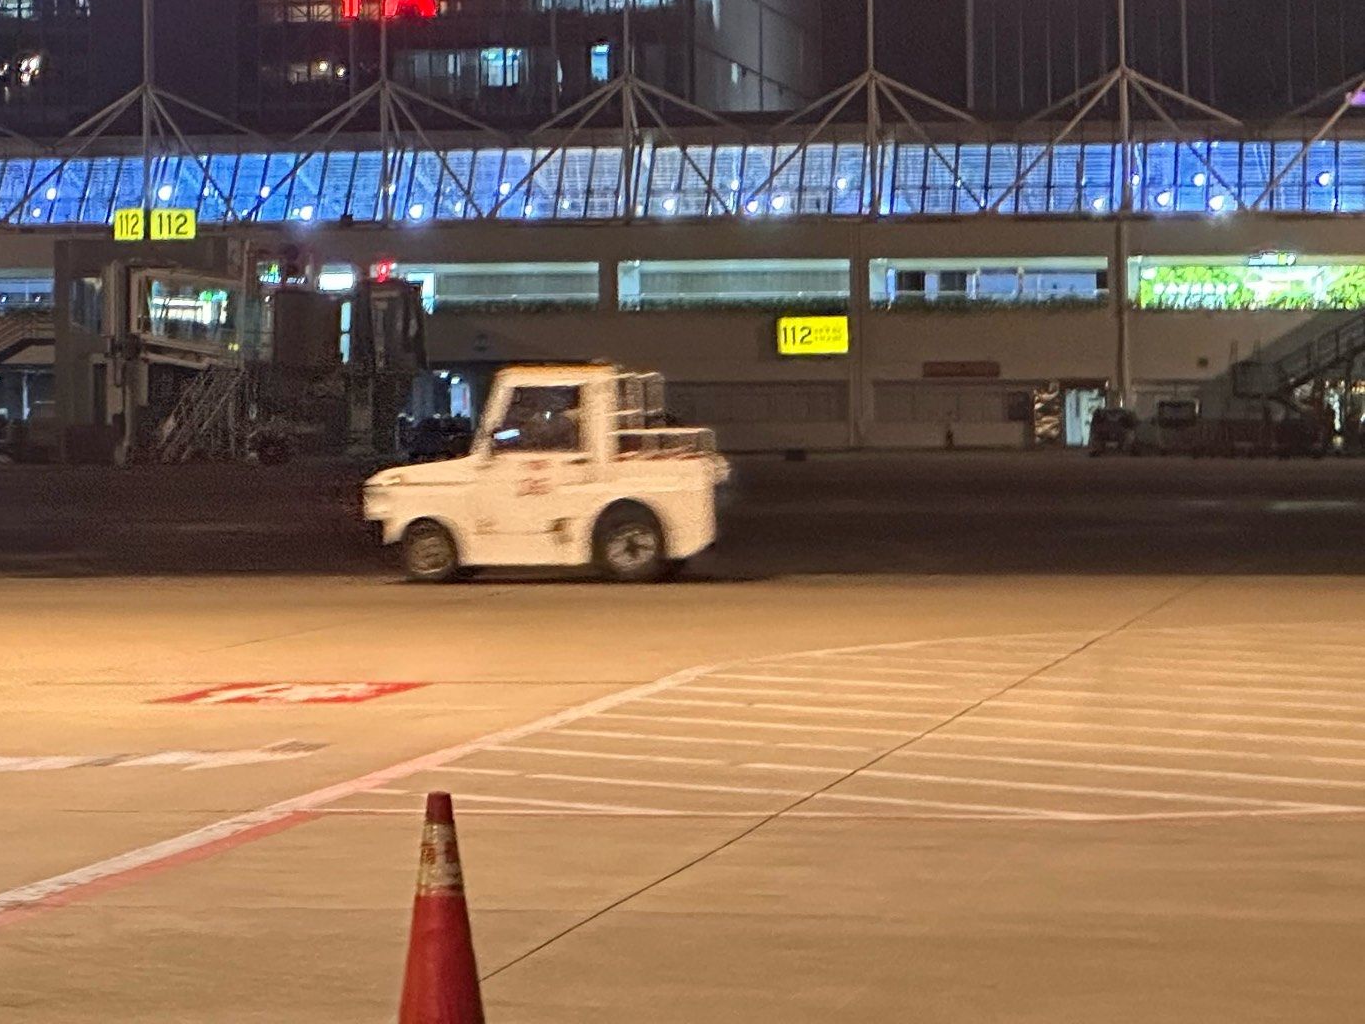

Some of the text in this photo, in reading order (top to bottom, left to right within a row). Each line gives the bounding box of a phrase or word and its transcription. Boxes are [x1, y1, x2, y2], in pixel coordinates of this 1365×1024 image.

[119, 213, 139, 236] 112
[158, 213, 188, 235] 112
[783, 326, 813, 345] 112
